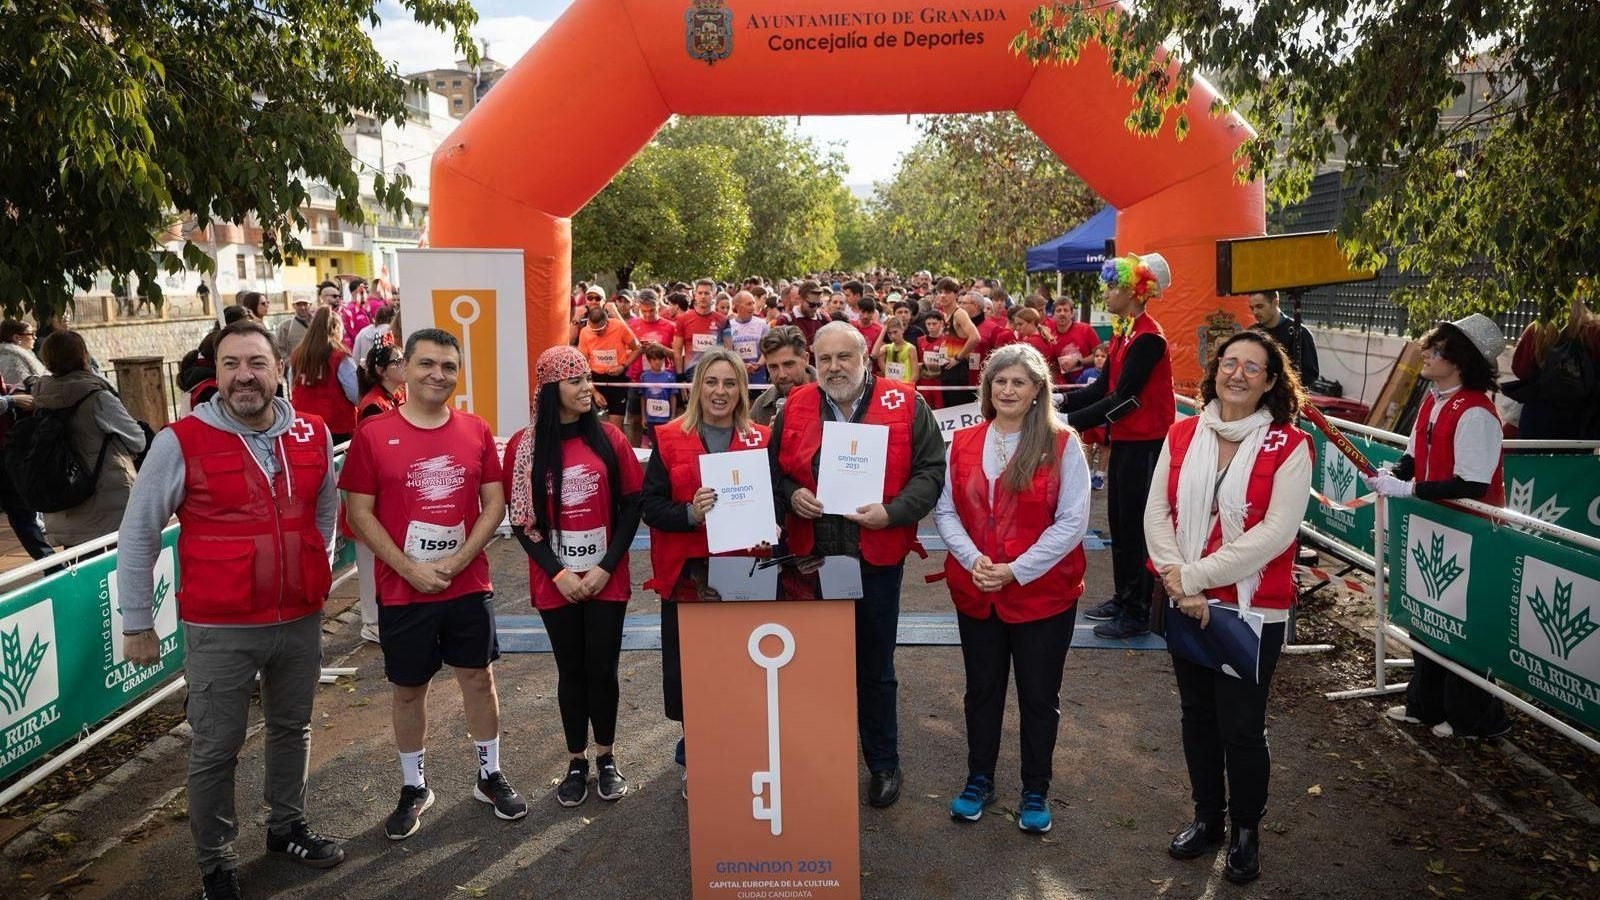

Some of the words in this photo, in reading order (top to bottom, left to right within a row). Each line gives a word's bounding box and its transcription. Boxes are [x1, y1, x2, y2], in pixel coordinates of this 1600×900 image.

[747, 12, 887, 29] AYUNTAMIENTO
[892, 11, 914, 24] DE
[920, 8, 1007, 24] GRANADA
[768, 31, 868, 54] Concejalía
[873, 32, 897, 48] de
[904, 30, 984, 49] Deportes
[961, 413, 985, 427] Ro
[420, 538, 458, 551] 1599
[561, 543, 597, 557] 1598
[1400, 514, 1408, 591] fundación
[1508, 555, 1523, 645] fundación
[99, 578, 113, 671] fundación
[1401, 595, 1421, 616] CAJA
[1423, 606, 1467, 640] RURAL
[1411, 616, 1450, 644] GRANADA
[105, 661, 137, 689] CAJA
[122, 661, 164, 692] GRANADA
[1509, 648, 1546, 679] CAJA
[1528, 674, 1585, 711] GRANADA
[5, 704, 60, 749] RURAL
[0, 734, 42, 768] ANADA
[478, 745, 488, 766] FILA
[716, 860, 794, 874] GRANADA
[798, 859, 833, 874] 2031
[709, 881, 741, 889] CAPITAL
[742, 880, 780, 888] EUROPEA
[737, 891, 766, 899] CIUDAD
[768, 890, 813, 898] CANDIDATA
